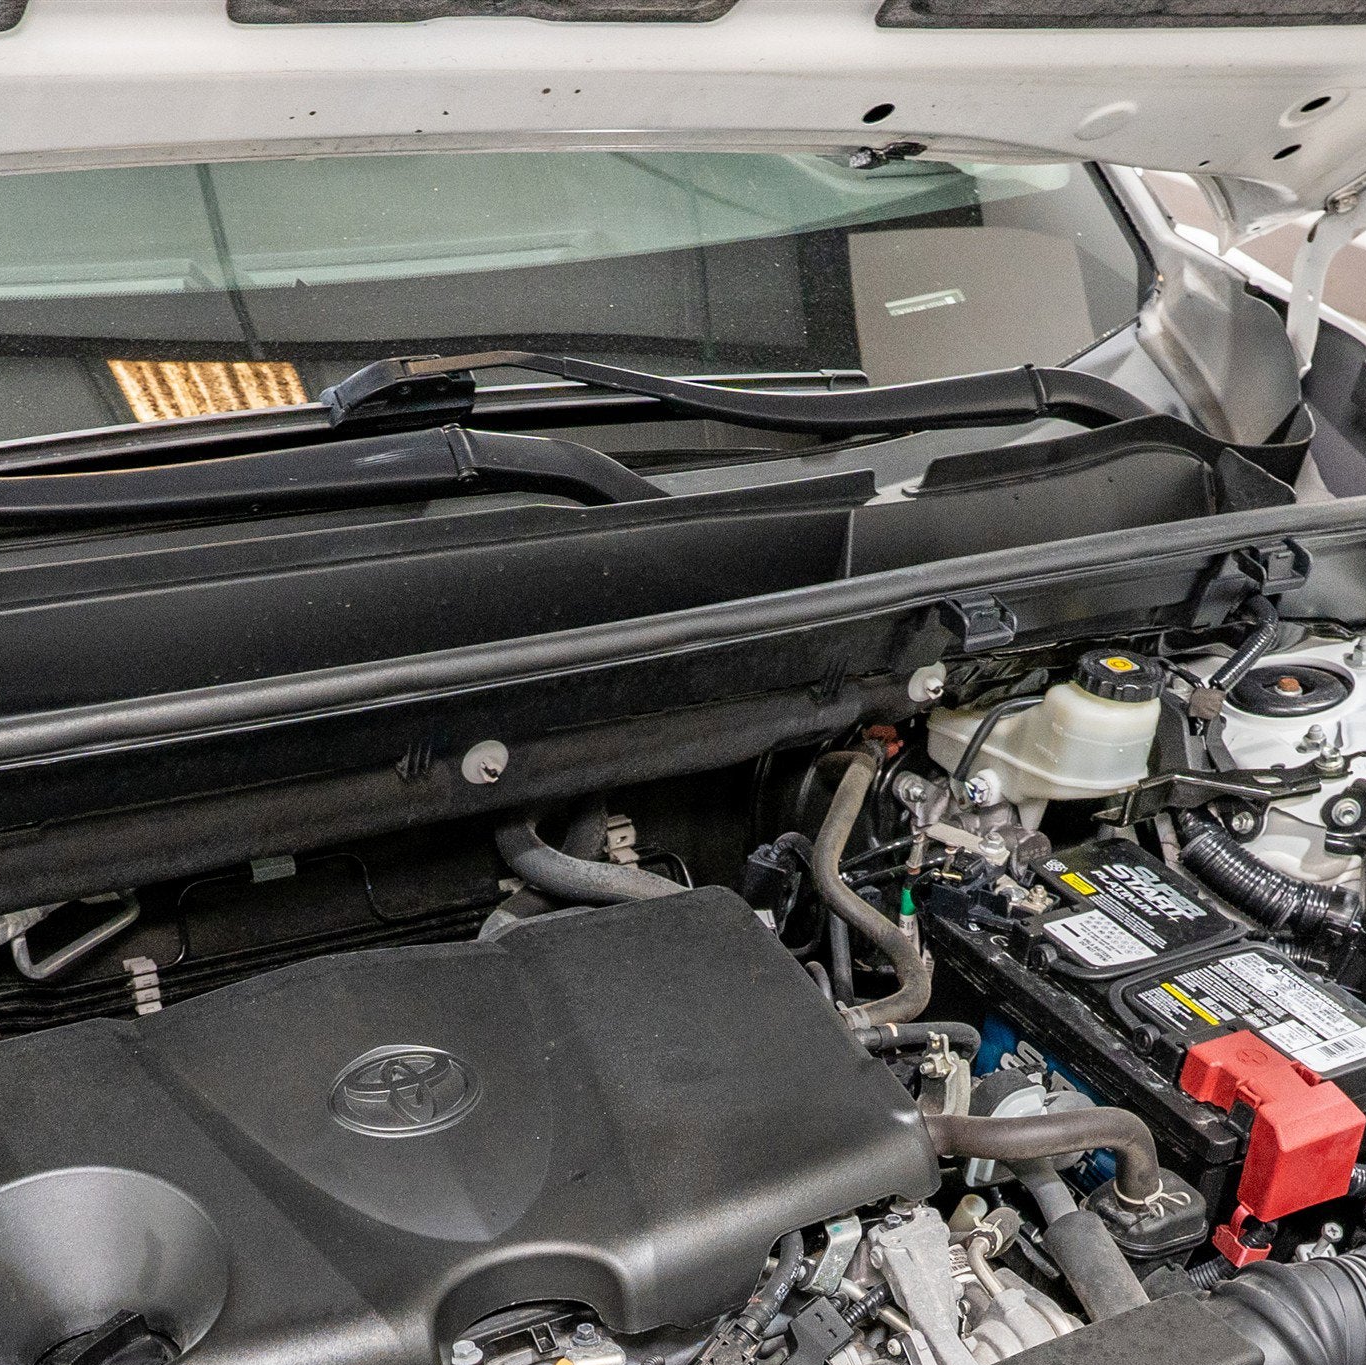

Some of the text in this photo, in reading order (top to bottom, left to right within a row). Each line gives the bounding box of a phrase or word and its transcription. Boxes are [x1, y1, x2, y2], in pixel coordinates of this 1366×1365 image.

[1090, 870, 1161, 917] PLATINUM
[1102, 864, 1195, 922] START
[1132, 865, 1208, 917] SUPER
